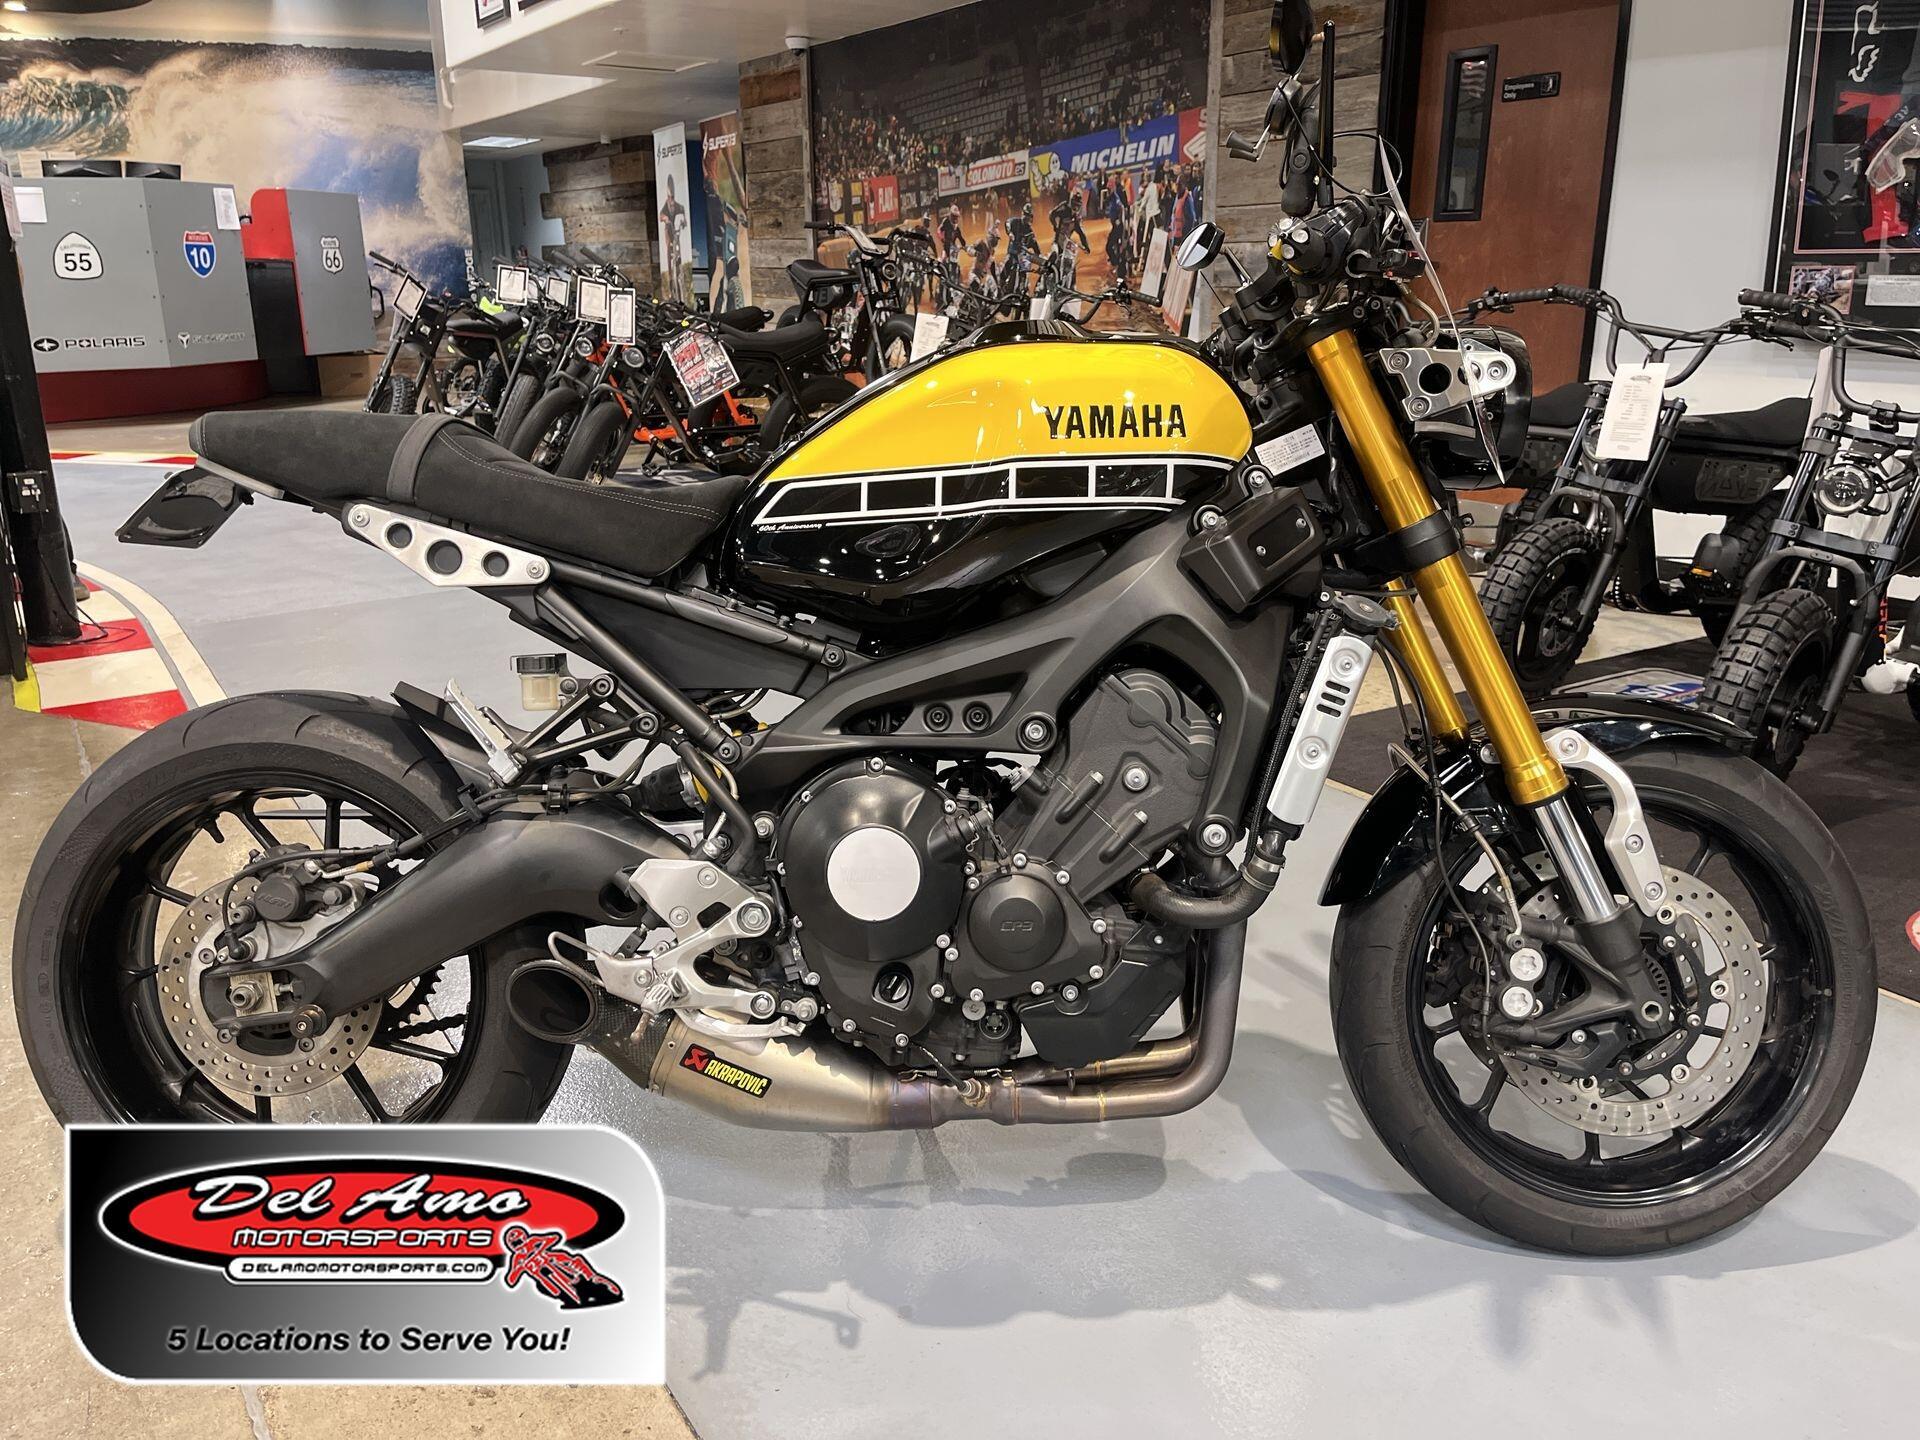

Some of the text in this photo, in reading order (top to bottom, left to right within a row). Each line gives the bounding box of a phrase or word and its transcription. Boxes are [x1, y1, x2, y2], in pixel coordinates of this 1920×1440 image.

[1504, 83, 1535, 91] Employees
[1071, 134, 1175, 173] MICHELIN
[967, 160, 1014, 187] SOLOMOTO
[64, 253, 92, 272] 55
[190, 247, 211, 269] 10
[325, 250, 340, 269] 66
[64, 336, 146, 349] POLARIS
[1043, 404, 1187, 439] YAMAHA
[758, 522, 823, 532] 60th Anniversary
[1000, 920, 1034, 932] CP3
